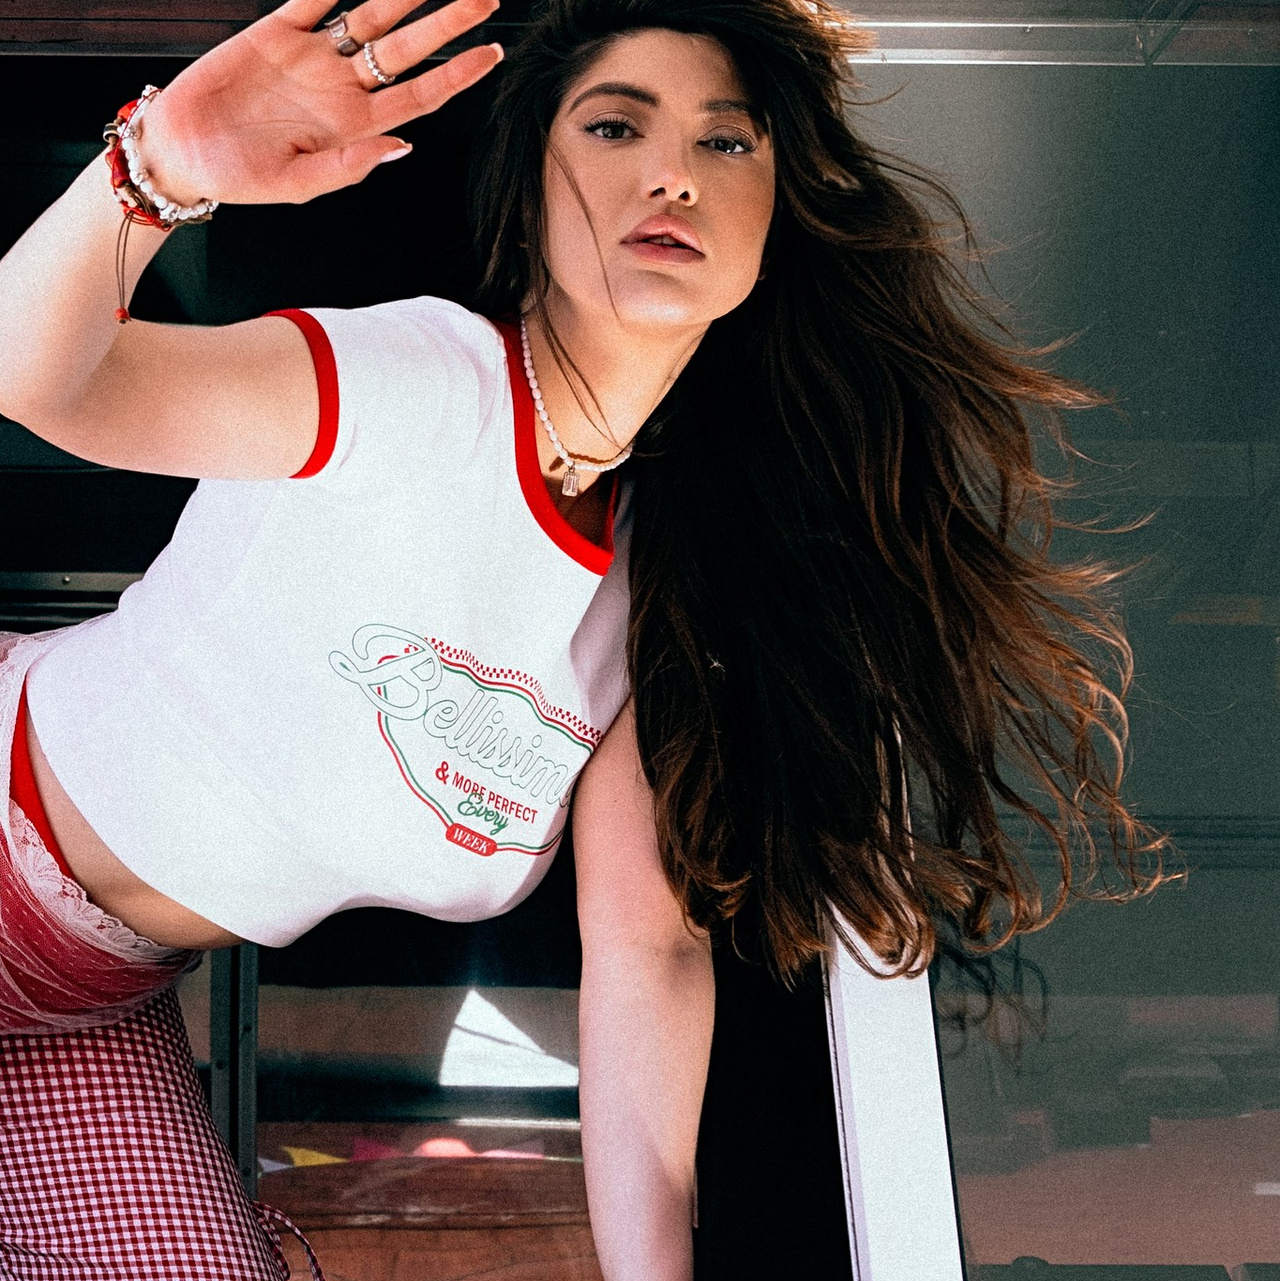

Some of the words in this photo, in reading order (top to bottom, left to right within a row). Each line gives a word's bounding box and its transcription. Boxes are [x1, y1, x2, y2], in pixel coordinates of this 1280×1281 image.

[435, 761, 449, 785] &
[452, 771, 486, 801] MORE
[487, 790, 538, 824] PERFECT
[457, 792, 508, 835] Every
[453, 827, 491, 854] WEEK
